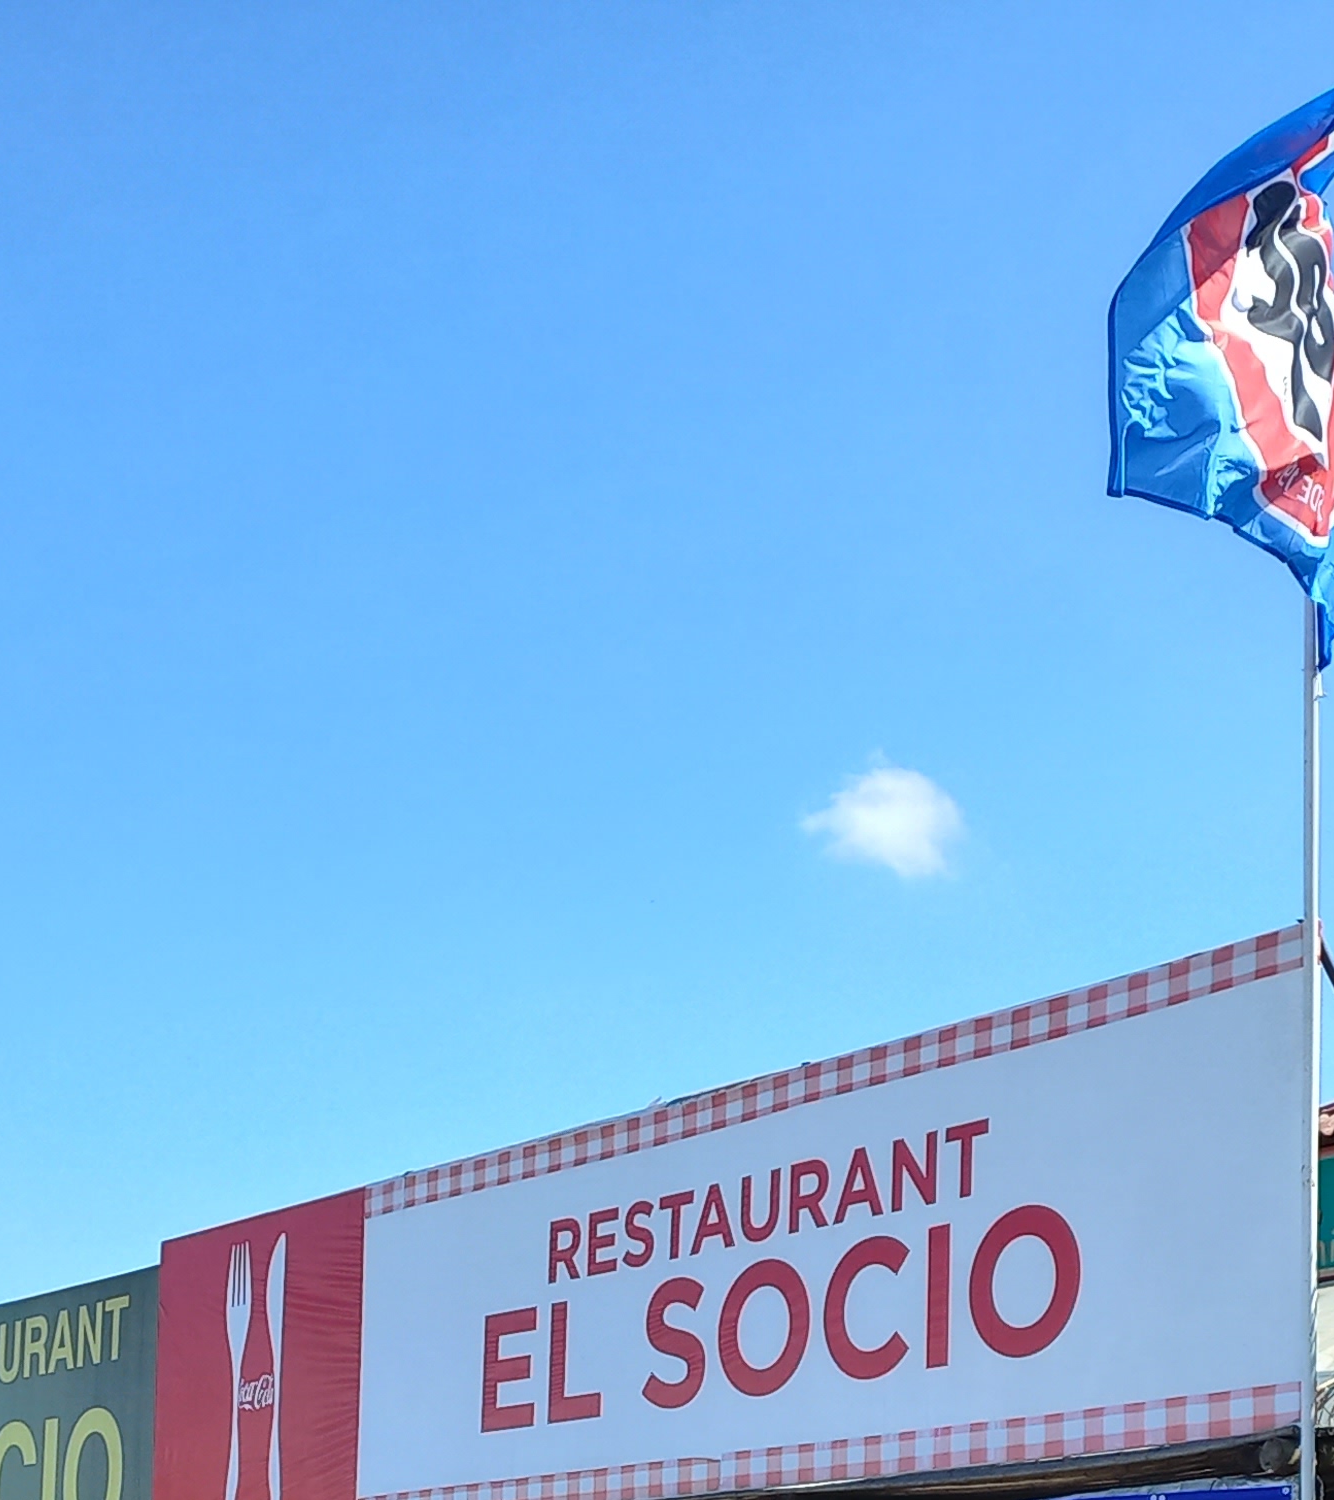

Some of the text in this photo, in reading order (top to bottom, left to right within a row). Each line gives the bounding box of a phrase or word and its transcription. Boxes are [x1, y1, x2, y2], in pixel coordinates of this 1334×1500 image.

[549, 1118, 990, 1284] RESTAURANT
[481, 1204, 1082, 1434] EL SOCIO
